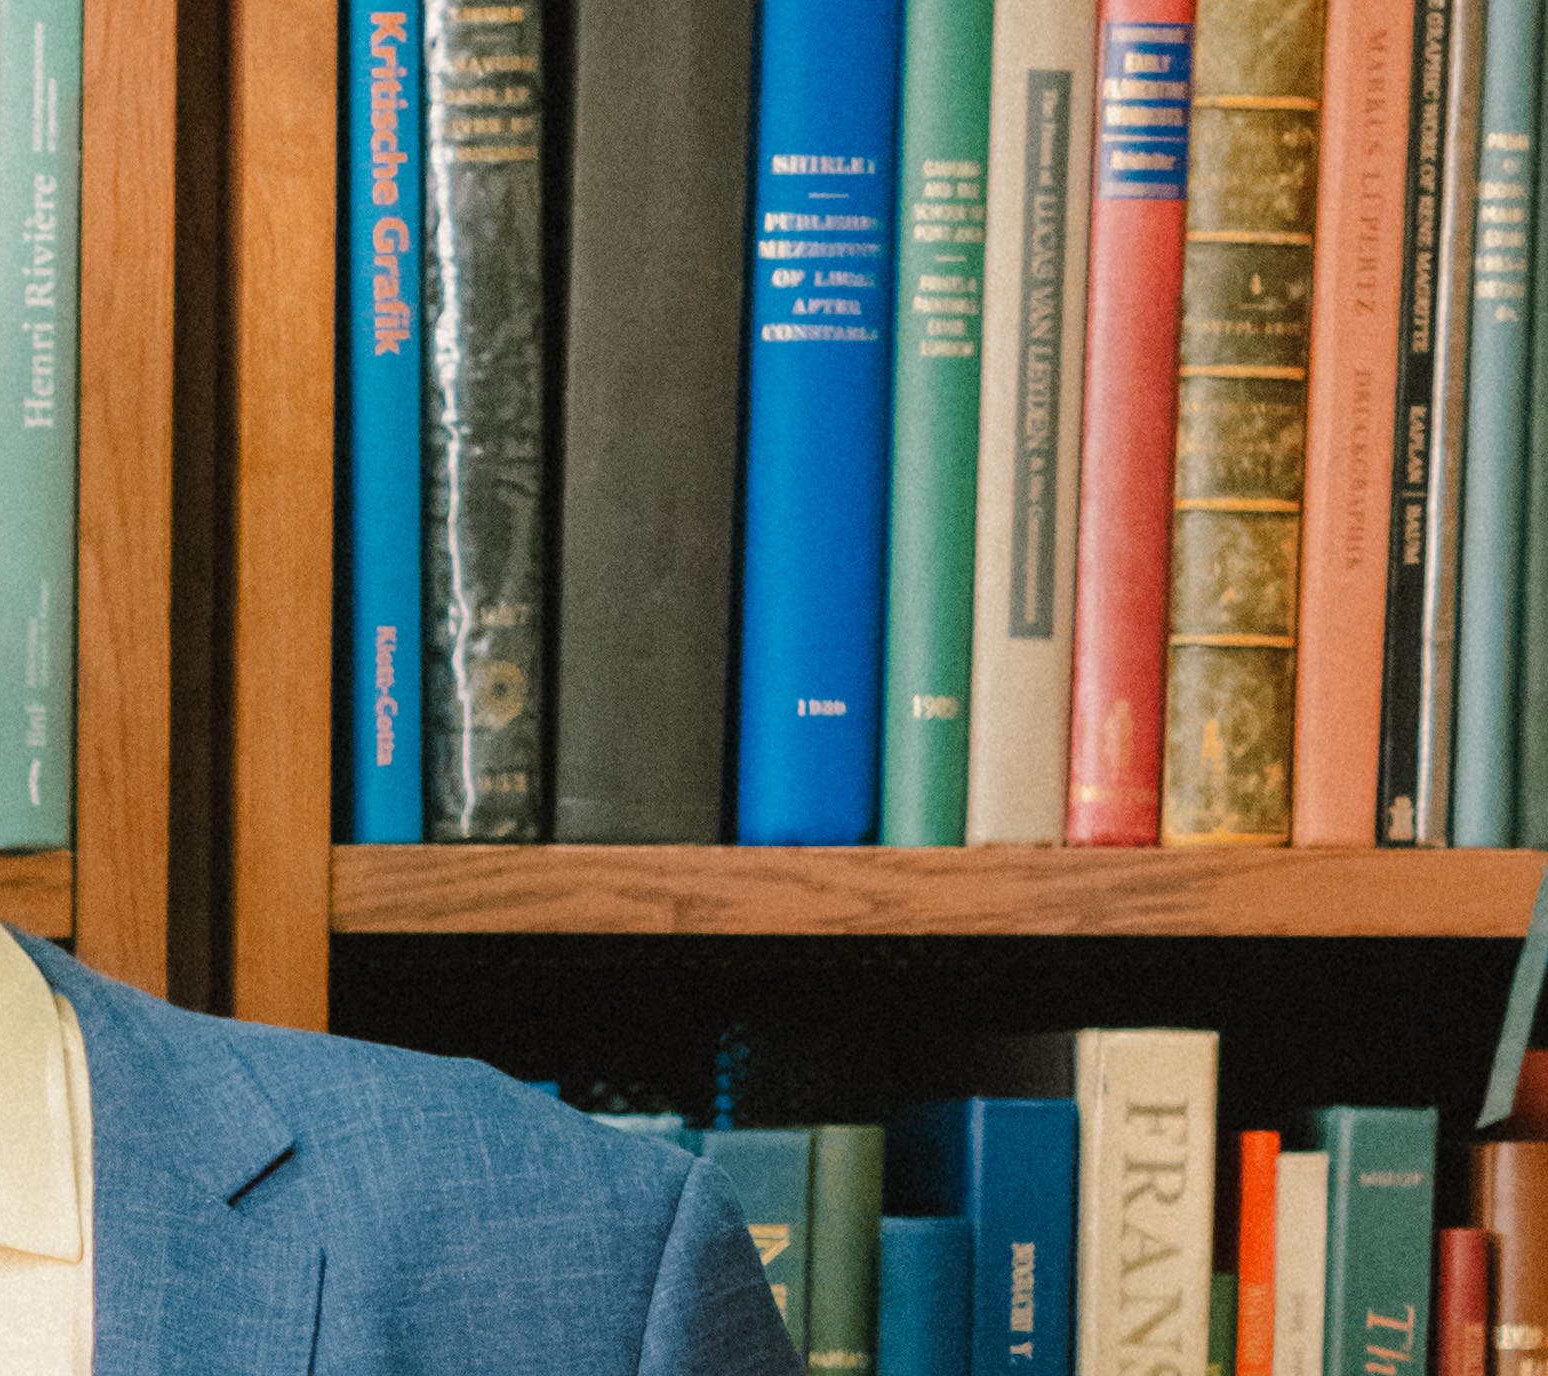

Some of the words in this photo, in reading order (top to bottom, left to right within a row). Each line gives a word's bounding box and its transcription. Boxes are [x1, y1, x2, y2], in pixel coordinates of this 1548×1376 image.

[1363, 28, 1391, 158] MARKUS
[1420, 12, 1445, 100] GRAPHIC
[370, 12, 408, 206] Kritische
[1418, 102, 1441, 161] WORK
[1418, 163, 1437, 193] OF
[22, 173, 57, 306] Rivière
[771, 270, 806, 287] OF
[1032, 195, 1058, 281] LUCAS
[372, 217, 411, 356] Grafik
[791, 298, 863, 315] AFTER
[1030, 285, 1054, 340] VAN
[1412, 250, 1433, 354] MAGRITTE
[22, 322, 56, 429] Henri
[1023, 344, 1053, 451] LEYDEN
[1407, 405, 1428, 483] KAPLAN
[1403, 504, 1423, 565] BAUM
[376, 625, 398, 766] Klett-Cotta
